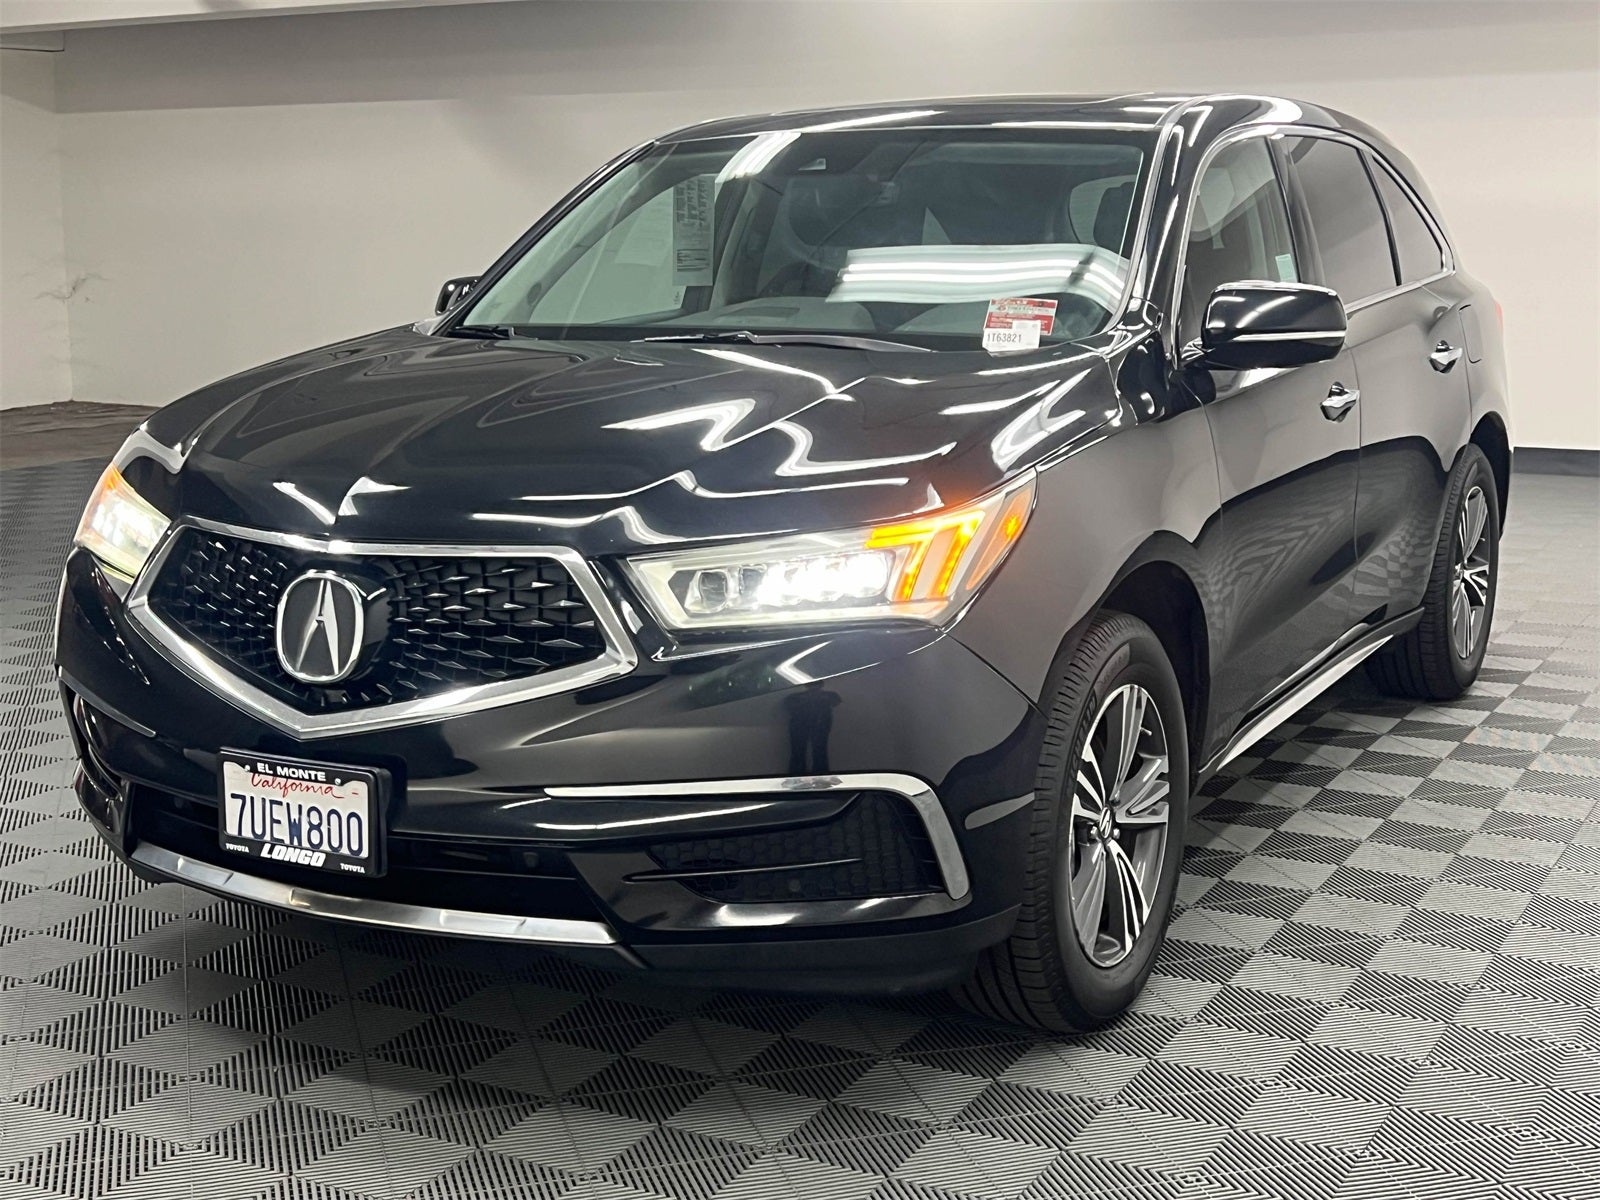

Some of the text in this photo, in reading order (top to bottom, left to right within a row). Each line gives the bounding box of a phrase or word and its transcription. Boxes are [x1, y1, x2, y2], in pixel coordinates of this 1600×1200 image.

[256, 762, 326, 781] EL MONTE
[250, 772, 345, 799] California
[230, 793, 363, 857] 7UEW800
[225, 843, 250, 853] TOYOTA
[260, 843, 326, 868] LONGO
[340, 863, 366, 874] TOYOTA
